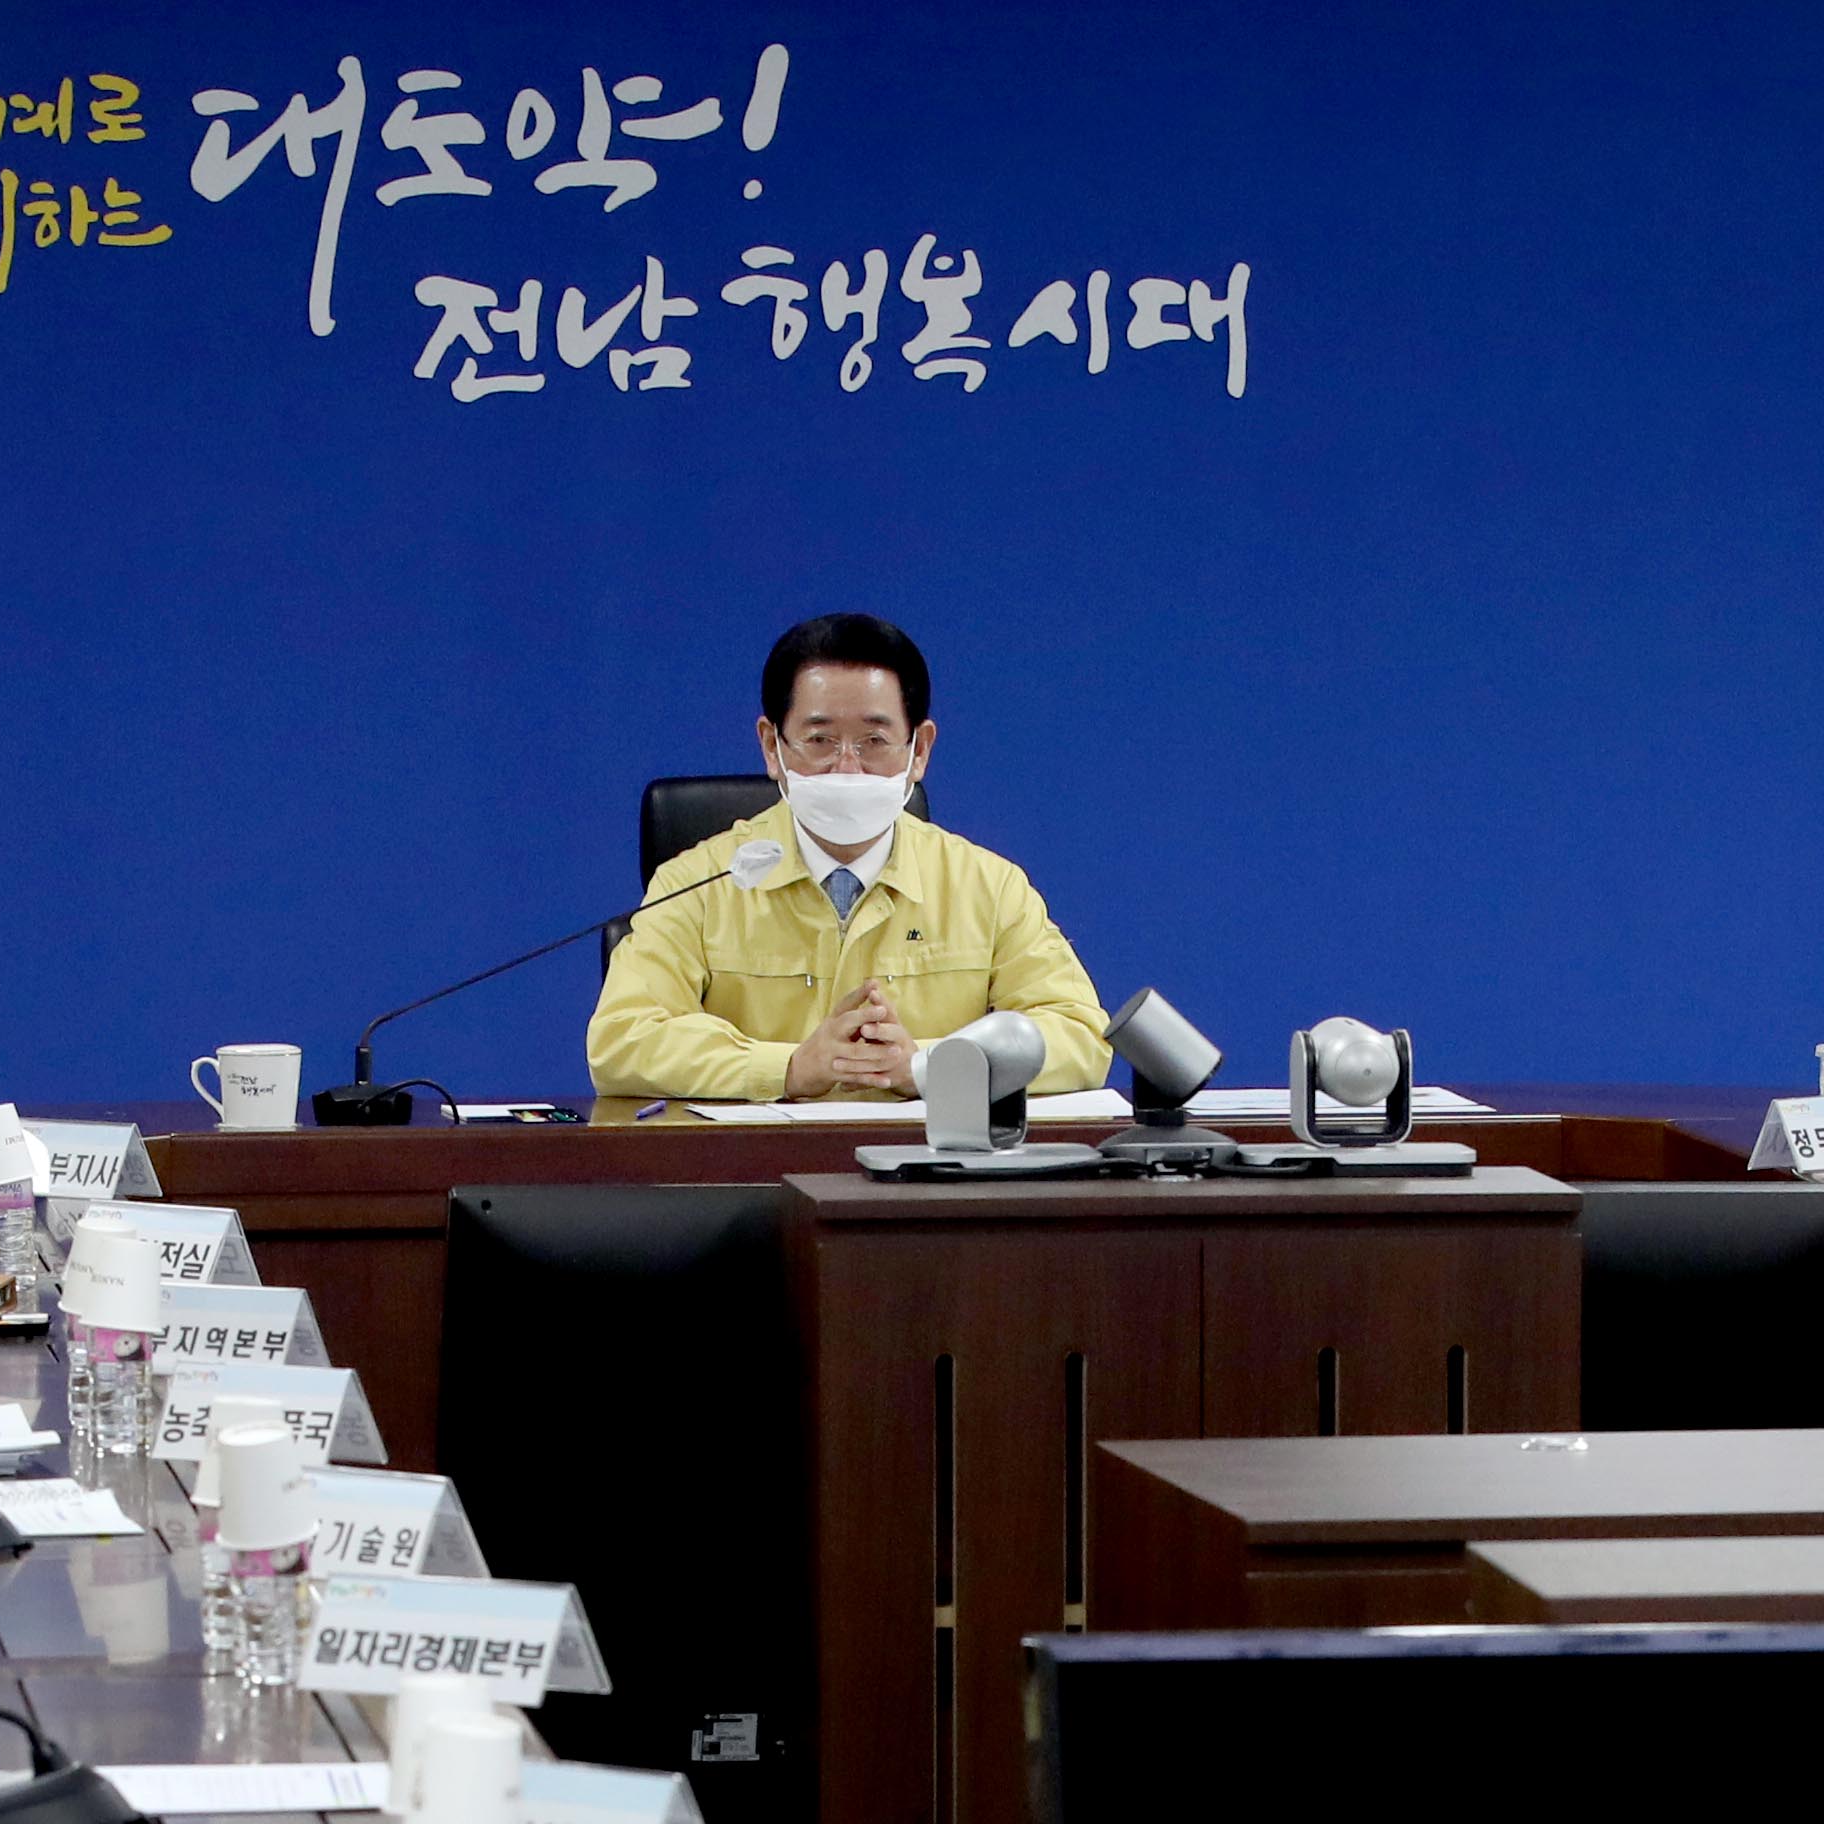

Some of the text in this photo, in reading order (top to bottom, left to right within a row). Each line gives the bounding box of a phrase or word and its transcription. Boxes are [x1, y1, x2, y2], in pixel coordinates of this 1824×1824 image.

[190, 43, 789, 337] 대도약!
[413, 253, 699, 404] 전남
[160, 1241, 211, 1280] 전실
[311, 1518, 421, 1568] 기술원
[314, 1627, 547, 1678] 일자리경제본부
